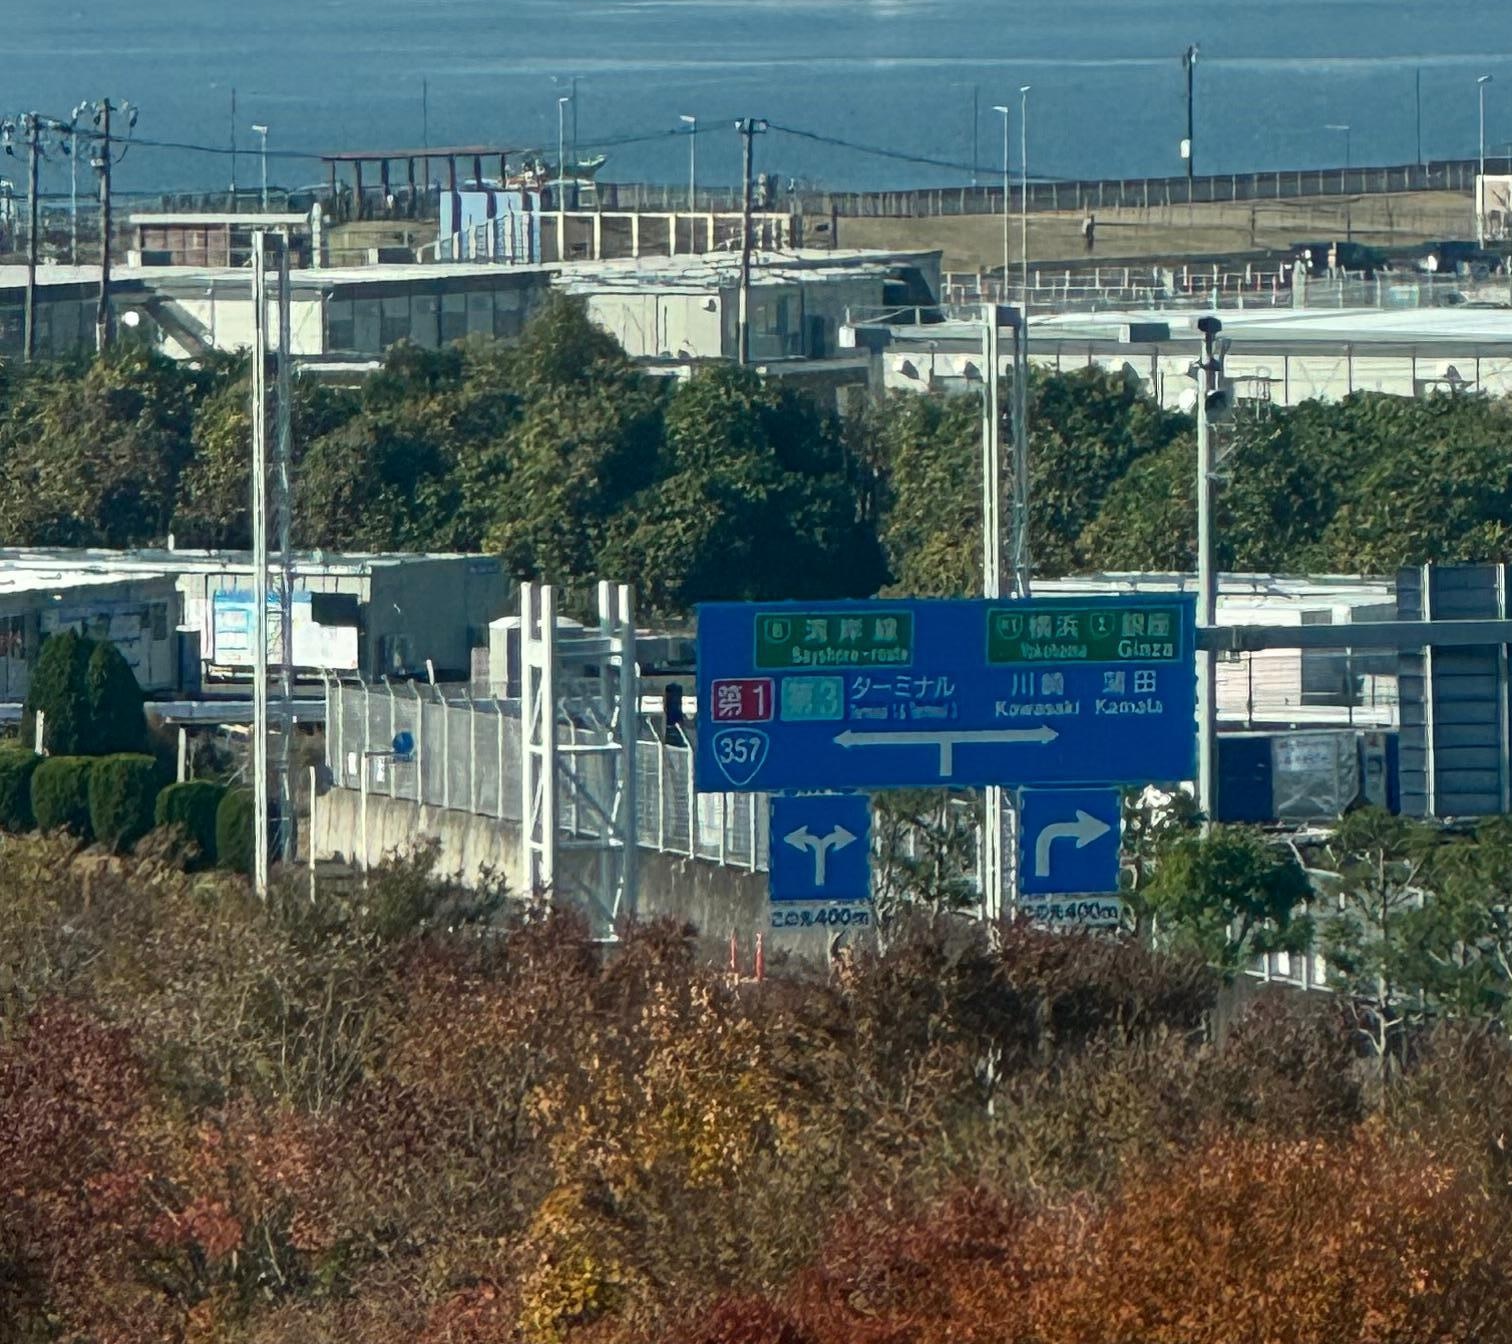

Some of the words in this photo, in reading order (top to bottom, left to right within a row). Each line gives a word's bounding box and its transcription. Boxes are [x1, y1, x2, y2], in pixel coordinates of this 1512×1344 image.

[1118, 640, 1173, 658] Ginza
[851, 676, 955, 699] ターミナル
[720, 737, 761, 763] 357
